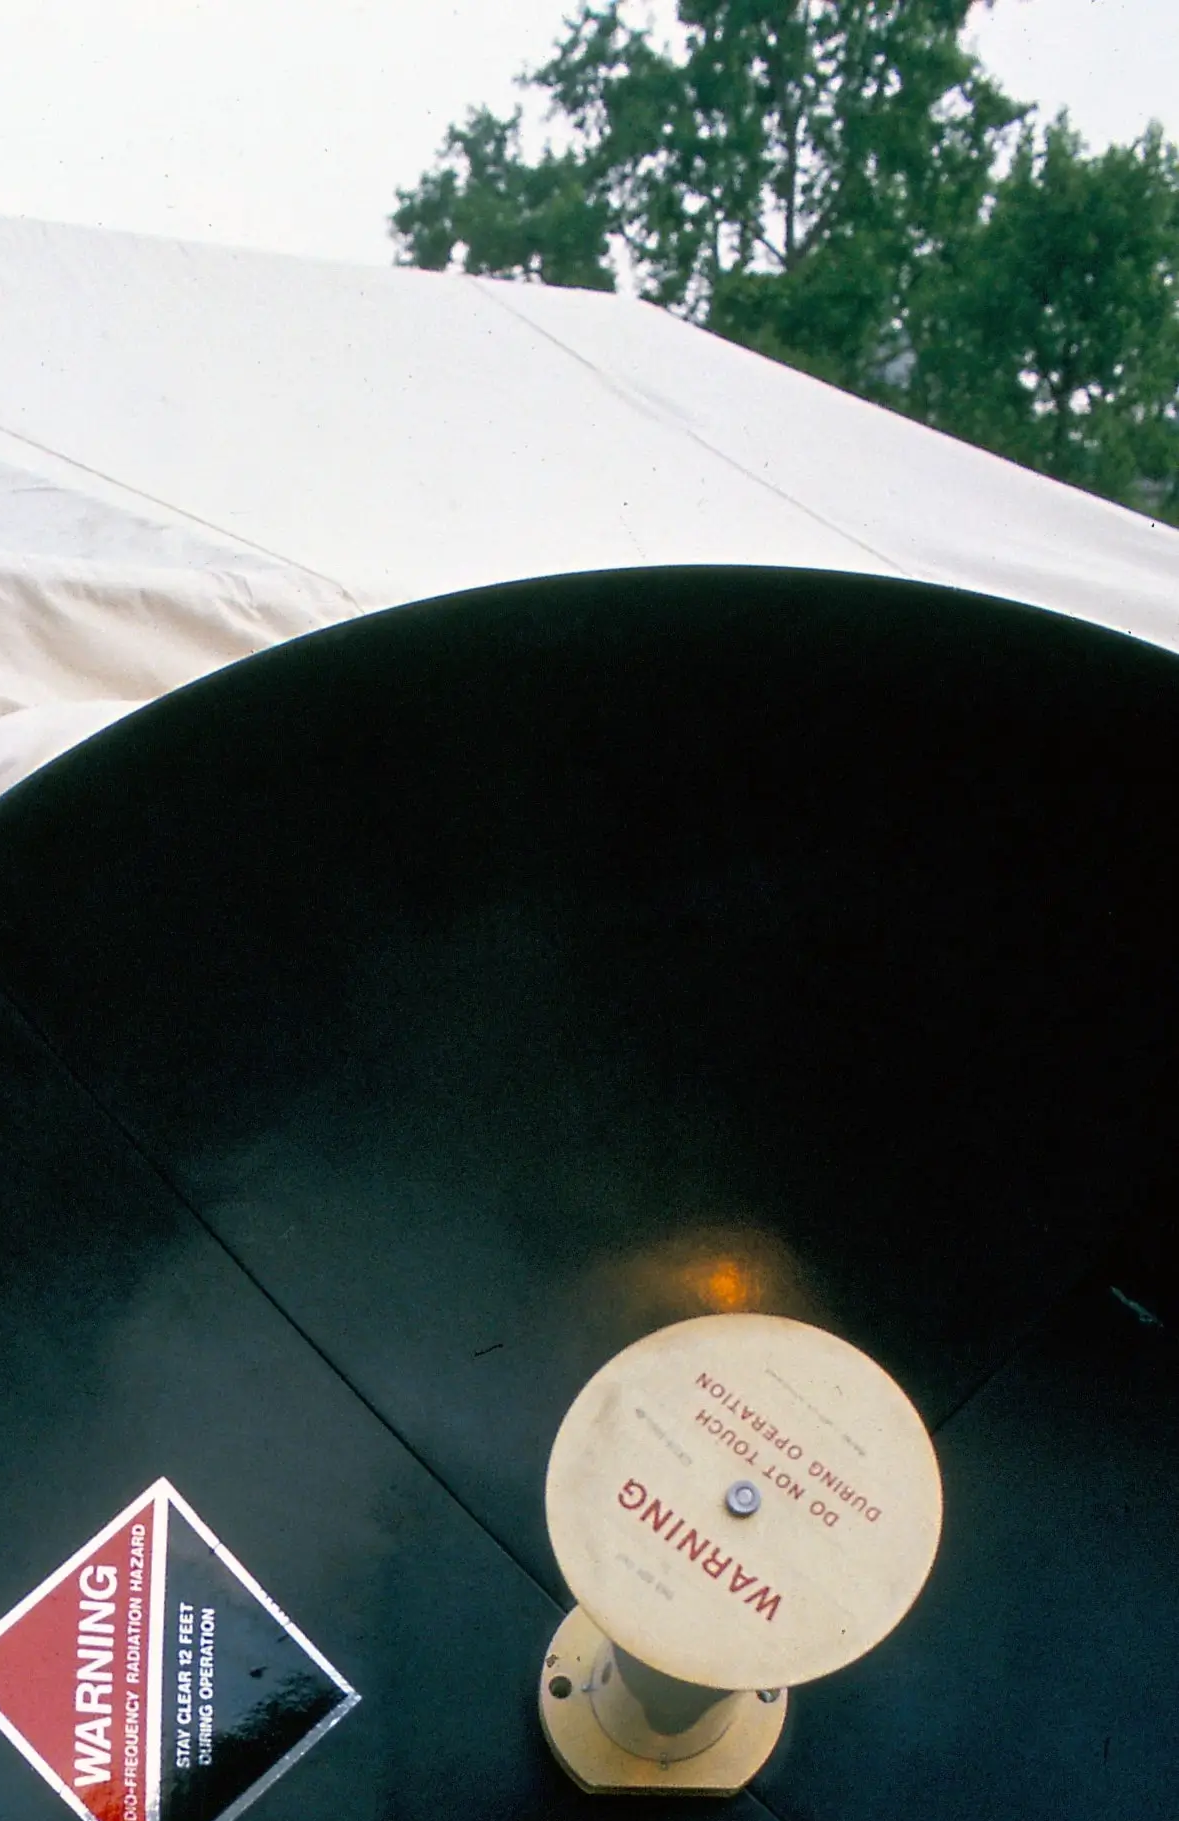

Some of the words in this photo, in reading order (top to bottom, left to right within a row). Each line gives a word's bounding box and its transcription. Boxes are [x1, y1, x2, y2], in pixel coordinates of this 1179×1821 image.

[693, 1371, 803, 1461] OPERATION
[694, 1408, 758, 1466] TOUCH
[762, 1464, 804, 1501] NOT
[808, 1459, 883, 1523] DURING
[809, 1499, 839, 1528] DO
[130, 1523, 146, 1592] HAZARD
[617, 1477, 783, 1622] WARNING
[127, 1591, 143, 1683] RADIATION
[180, 1601, 195, 1644] FEET
[201, 1607, 215, 1698] OPERATION
[74, 1565, 118, 1788] WARNING
[180, 1646, 192, 1665] 12
[178, 1669, 192, 1724] CLEAR
[176, 1729, 191, 1768] STAY
[199, 1700, 213, 1766] DURING
